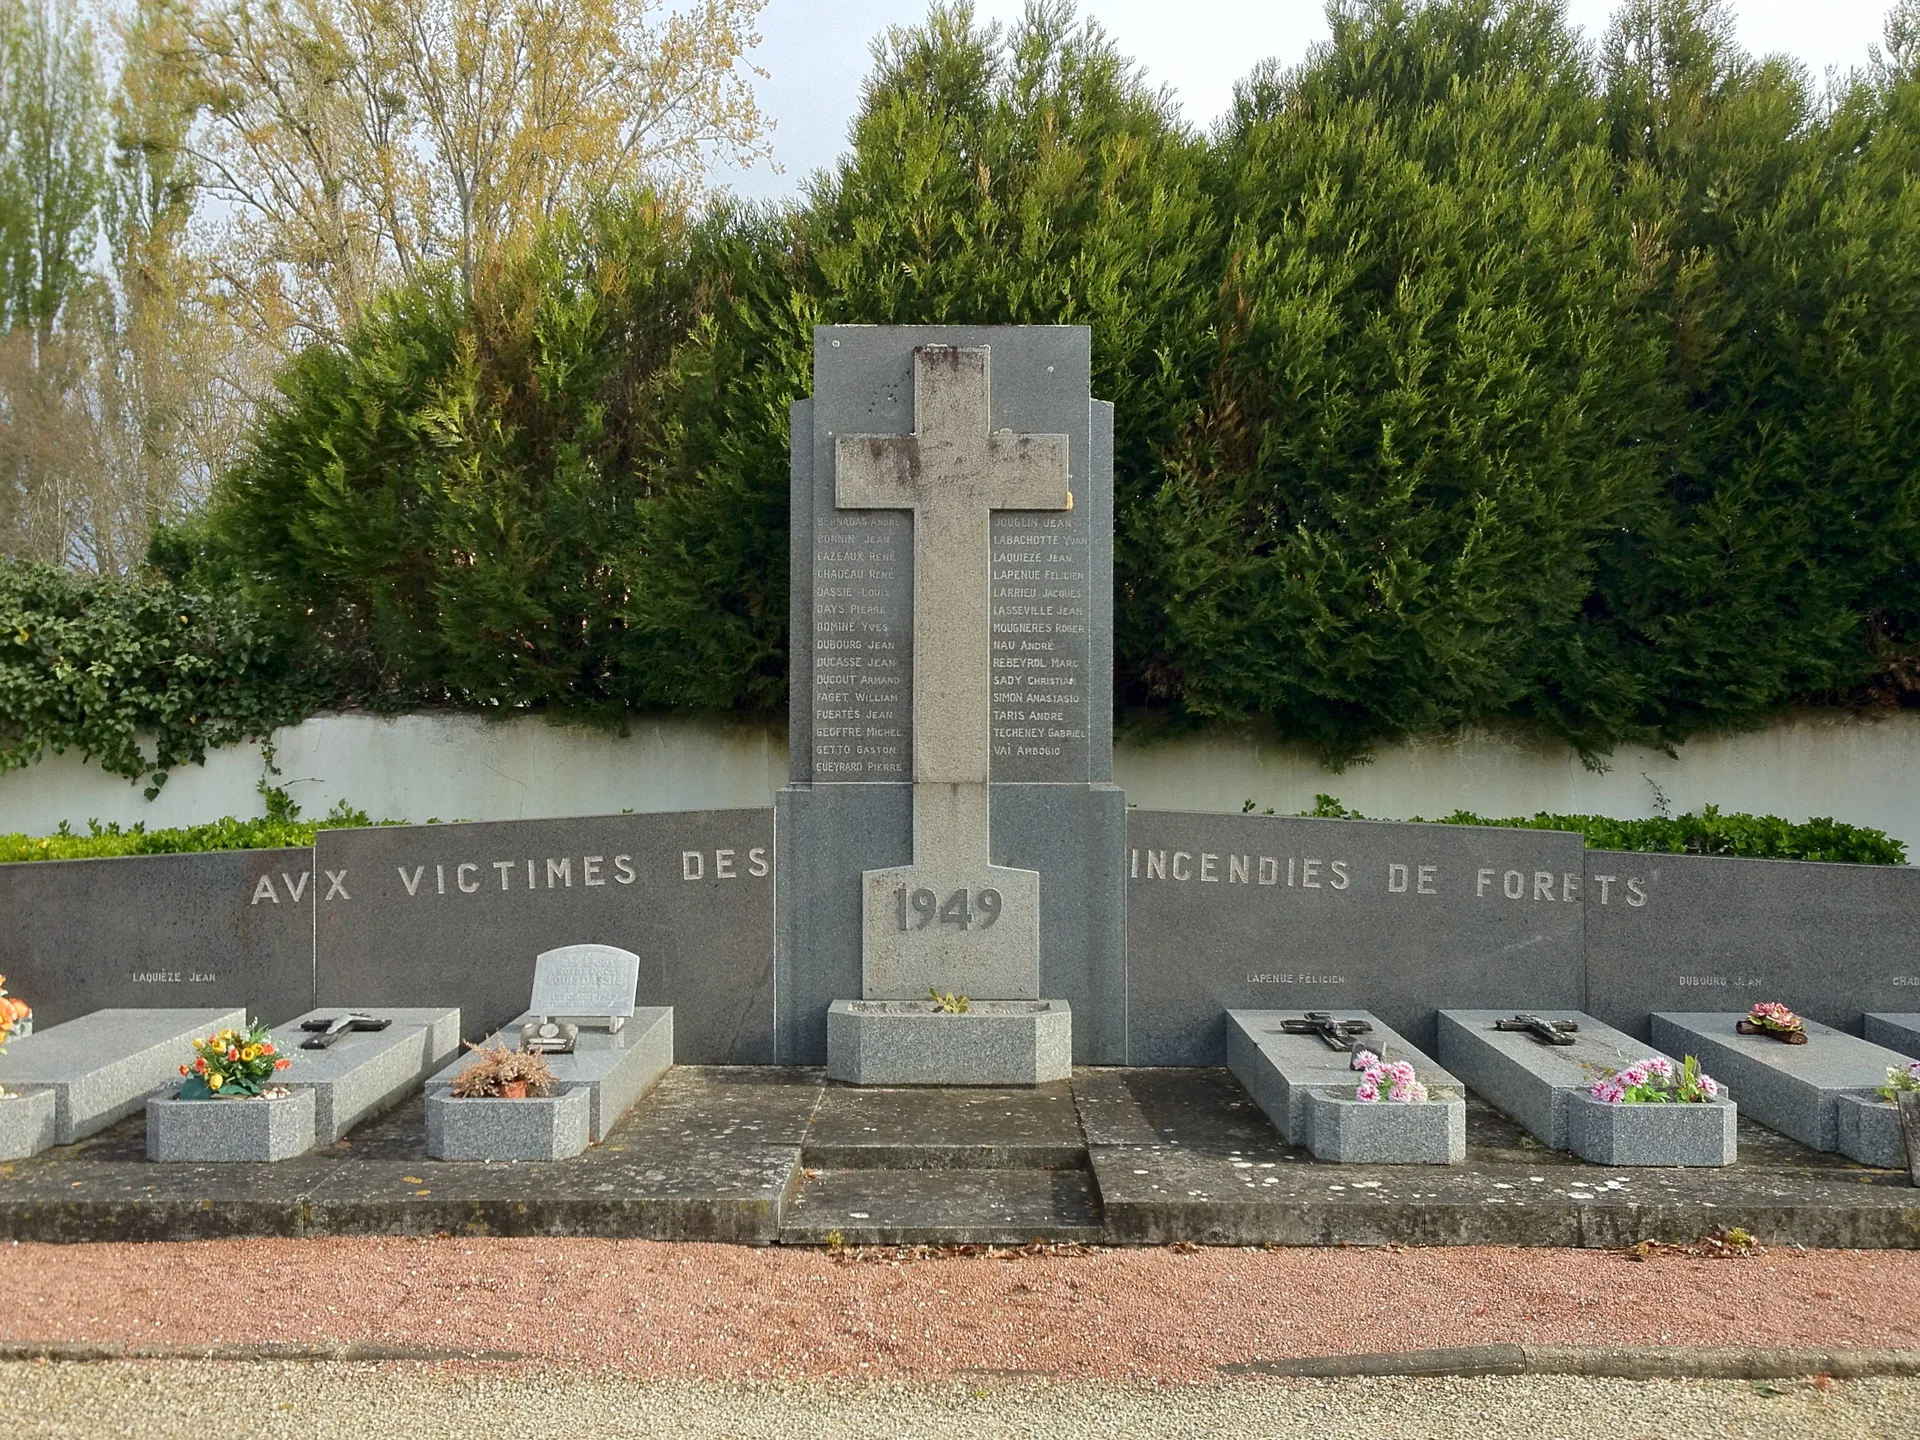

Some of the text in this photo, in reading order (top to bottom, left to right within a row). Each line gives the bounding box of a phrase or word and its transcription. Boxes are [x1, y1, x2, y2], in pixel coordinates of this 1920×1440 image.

[994, 517, 1072, 528] JOUGLIN JEAN
[817, 534, 890, 545] BONNIN JEAN
[993, 535, 1089, 546] LABACHOTTE YVAN
[817, 551, 864, 562] CAZEAUX
[1046, 553, 1073, 563] JEAN
[817, 569, 864, 580] CHADEAU
[993, 570, 1041, 580] LAPENUE
[861, 588, 890, 597] LOUIS
[993, 587, 1082, 599] LARRIEU JACQUES
[817, 604, 886, 615] DAYS PIERRE
[993, 605, 1083, 616] LASSEVILLE JEAN
[861, 621, 888, 632] YVES
[1055, 623, 1086, 633] ROGER
[817, 640, 895, 650] DUBOURG JEAN
[993, 639, 1054, 651] NAU ANDRÉ
[817, 657, 896, 667] DUCASSE JEAN
[993, 657, 1080, 668] REBEYROL MARC
[860, 675, 900, 685] ARMAND
[993, 675, 1077, 686] SADY CHRISTIAN
[816, 692, 898, 703] FAGET WILLIAM
[993, 692, 1080, 703] SIMON ANASTASIO
[865, 710, 893, 719] JEAN
[993, 710, 1025, 720] TARIS
[866, 727, 902, 737] MICHEL
[993, 728, 1087, 738] TECHENEY GABRIEL
[816, 745, 896, 755] GETTO GASTON
[1016, 745, 1061, 756] AMBOGIO
[816, 762, 902, 772] GUEYRARD PIERRE
[397, 853, 638, 896] VICTIMES
[682, 847, 770, 881] DES
[1130, 848, 1650, 908] INCENDIES DE FORETS
[893, 887, 1003, 931] 1949
[189, 973, 217, 983] JEAN
[546, 975, 579, 986] LOUIS
[1246, 973, 1294, 984] LAPENUE
[1679, 976, 1728, 987] DUBOURG
